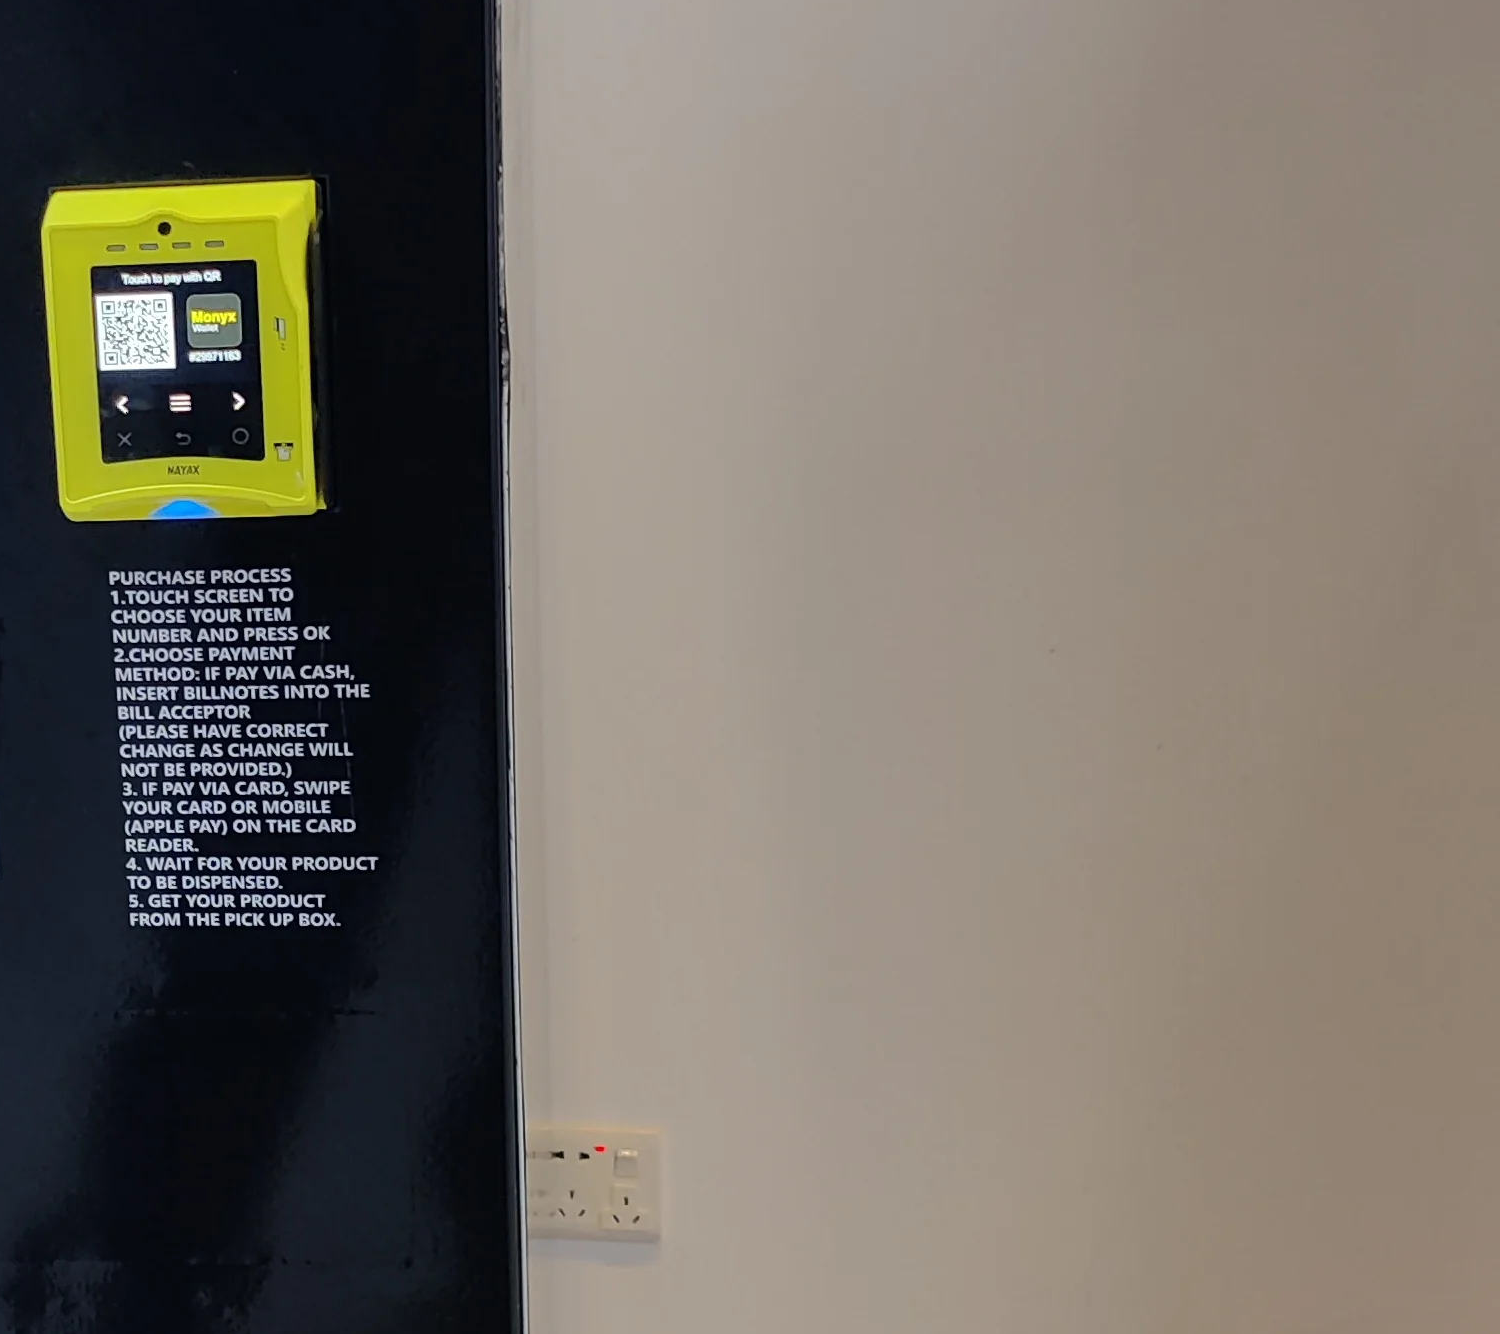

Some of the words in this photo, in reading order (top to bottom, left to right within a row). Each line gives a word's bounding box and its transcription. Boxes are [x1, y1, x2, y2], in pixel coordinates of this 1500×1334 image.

[191, 310, 237, 326] Monyx
[109, 571, 205, 585] PURCHASE
[211, 568, 291, 583] PROCESS
[111, 590, 188, 604] 1.TOUCH
[194, 589, 263, 603] SCREEN
[268, 588, 293, 601] TO
[111, 609, 186, 623] CHOOSE
[190, 609, 242, 623] YOUR
[247, 607, 291, 621] ITEM
[113, 629, 192, 643] NUMBER
[197, 628, 238, 642] AND
[244, 627, 298, 641] PRESS
[304, 626, 330, 640] OK
[114, 648, 203, 662] 2.CHOOSE
[209, 647, 295, 661] PAYMENT
[115, 667, 200, 681] METHOD:
[205, 667, 220, 680] IF
[226, 667, 258, 680] PAY
[263, 666, 295, 679] VIA
[300, 665, 354, 680] CASH,
[117, 687, 179, 701] INSERT
[184, 685, 279, 700] BILLNOTES
[285, 685, 329, 699] INTO
[334, 684, 370, 698] THE
[118, 706, 154, 719] BILL
[159, 705, 251, 719] ACCEPTOR
[119, 725, 188, 741] (PLEASE
[194, 725, 241, 738] HAVE
[246, 723, 328, 737] CORRECT
[120, 744, 195, 758] CHANGE
[200, 744, 223, 757] AS
[228, 743, 304, 757] CHANGE
[309, 743, 353, 756] WILL
[121, 763, 159, 777] NOT
[164, 763, 185, 776] BE
[191, 763, 292, 778] PROVIDED.)
[123, 782, 137, 796] 3.
[142, 782, 157, 795] IF
[163, 782, 194, 795] PAY
[199, 782, 230, 795] VIA
[235, 781, 288, 797] CARD,
[294, 781, 350, 795] SWIPE
[123, 801, 172, 815] YOUR
[177, 801, 226, 814] CARD
[231, 801, 258, 814] OR
[263, 800, 331, 813] MOBILE
[125, 820, 184, 836] (APPLE
[190, 820, 227, 835] PAY)
[233, 819, 261, 833] ON
[266, 819, 301, 833] THE
[306, 819, 356, 833] CARD
[126, 839, 199, 852] READER.
[126, 857, 142, 870] 4.
[146, 857, 193, 871] WAIT
[198, 857, 233, 870] FOR
[237, 857, 287, 870] YOUR
[292, 857, 378, 871] PRODUCT
[126, 876, 151, 889] TO
[156, 876, 177, 889] BE
[182, 876, 283, 889] DISPENSED.
[129, 895, 144, 907] 5.
[148, 894, 182, 907] GET
[186, 895, 236, 907] YOUR
[241, 895, 325, 907] PRODUCT
[130, 913, 180, 926] FROM
[185, 913, 220, 926] THE
[225, 913, 264, 926] PICK
[270, 913, 293, 926] UP
[299, 913, 340, 926] BOX.
